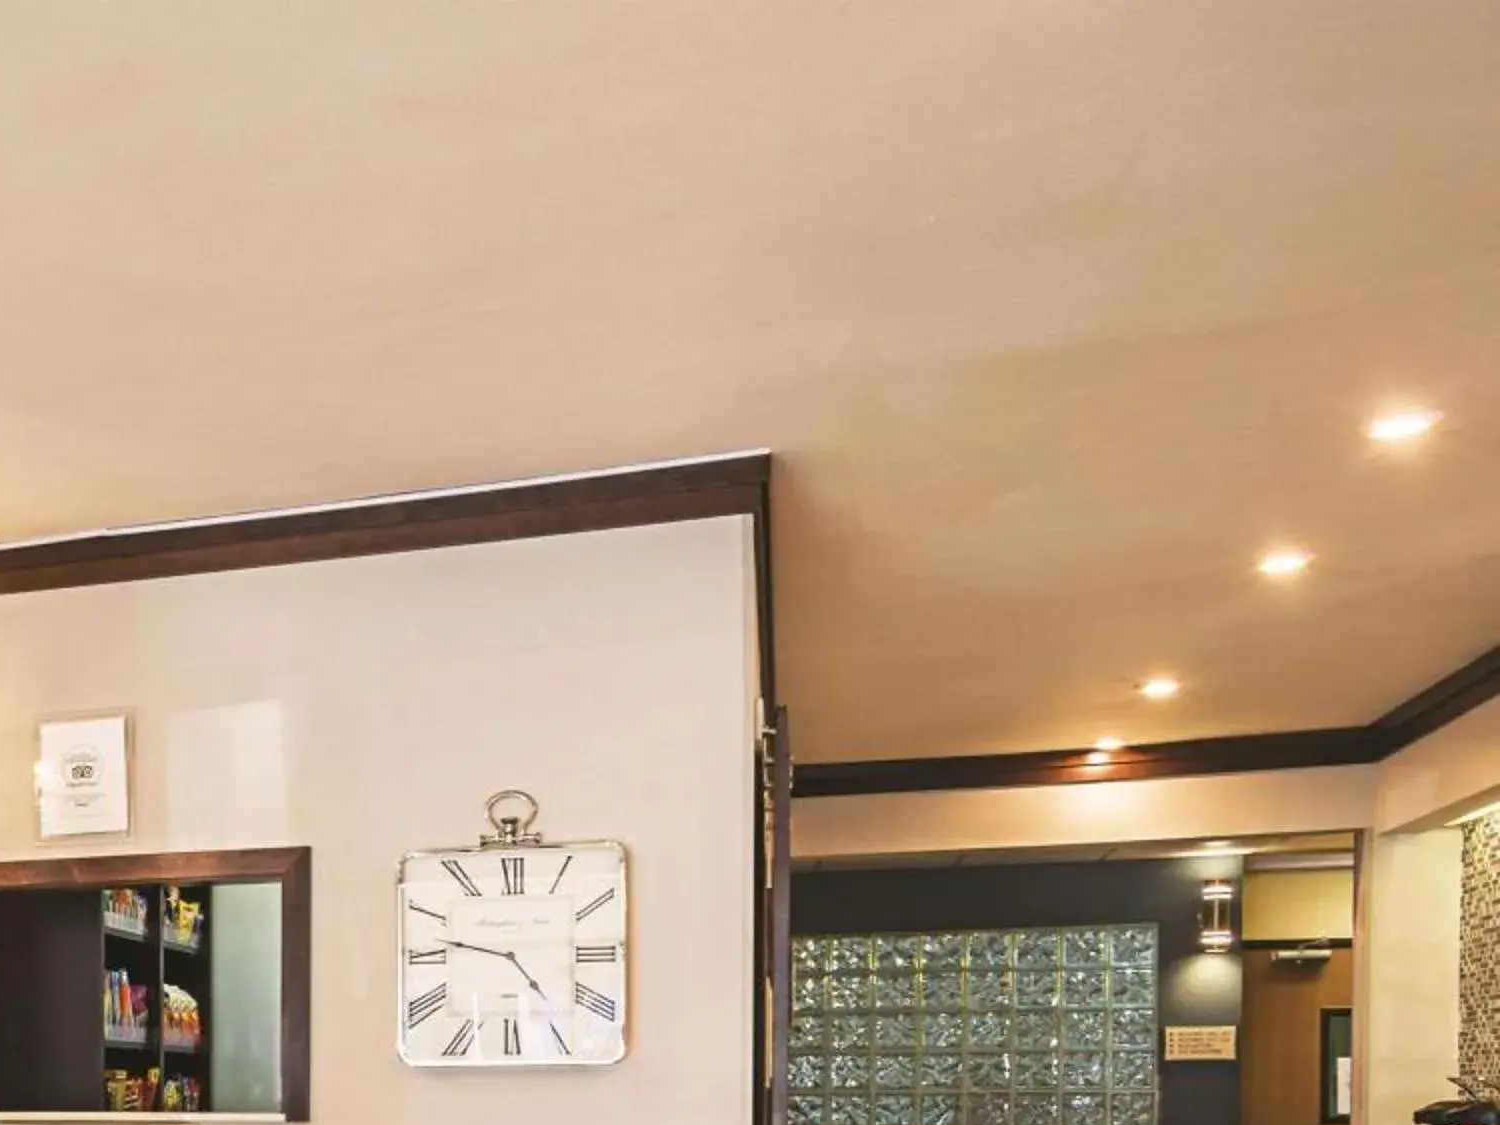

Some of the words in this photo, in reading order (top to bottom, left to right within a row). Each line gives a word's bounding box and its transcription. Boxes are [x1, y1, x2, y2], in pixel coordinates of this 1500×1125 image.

[441, 860, 482, 896] XI
[501, 857, 525, 895] XII
[549, 855, 573, 894] I
[576, 888, 615, 921] II
[408, 949, 447, 965] IX
[576, 945, 616, 963] III
[503, 1018, 521, 1056] VI
